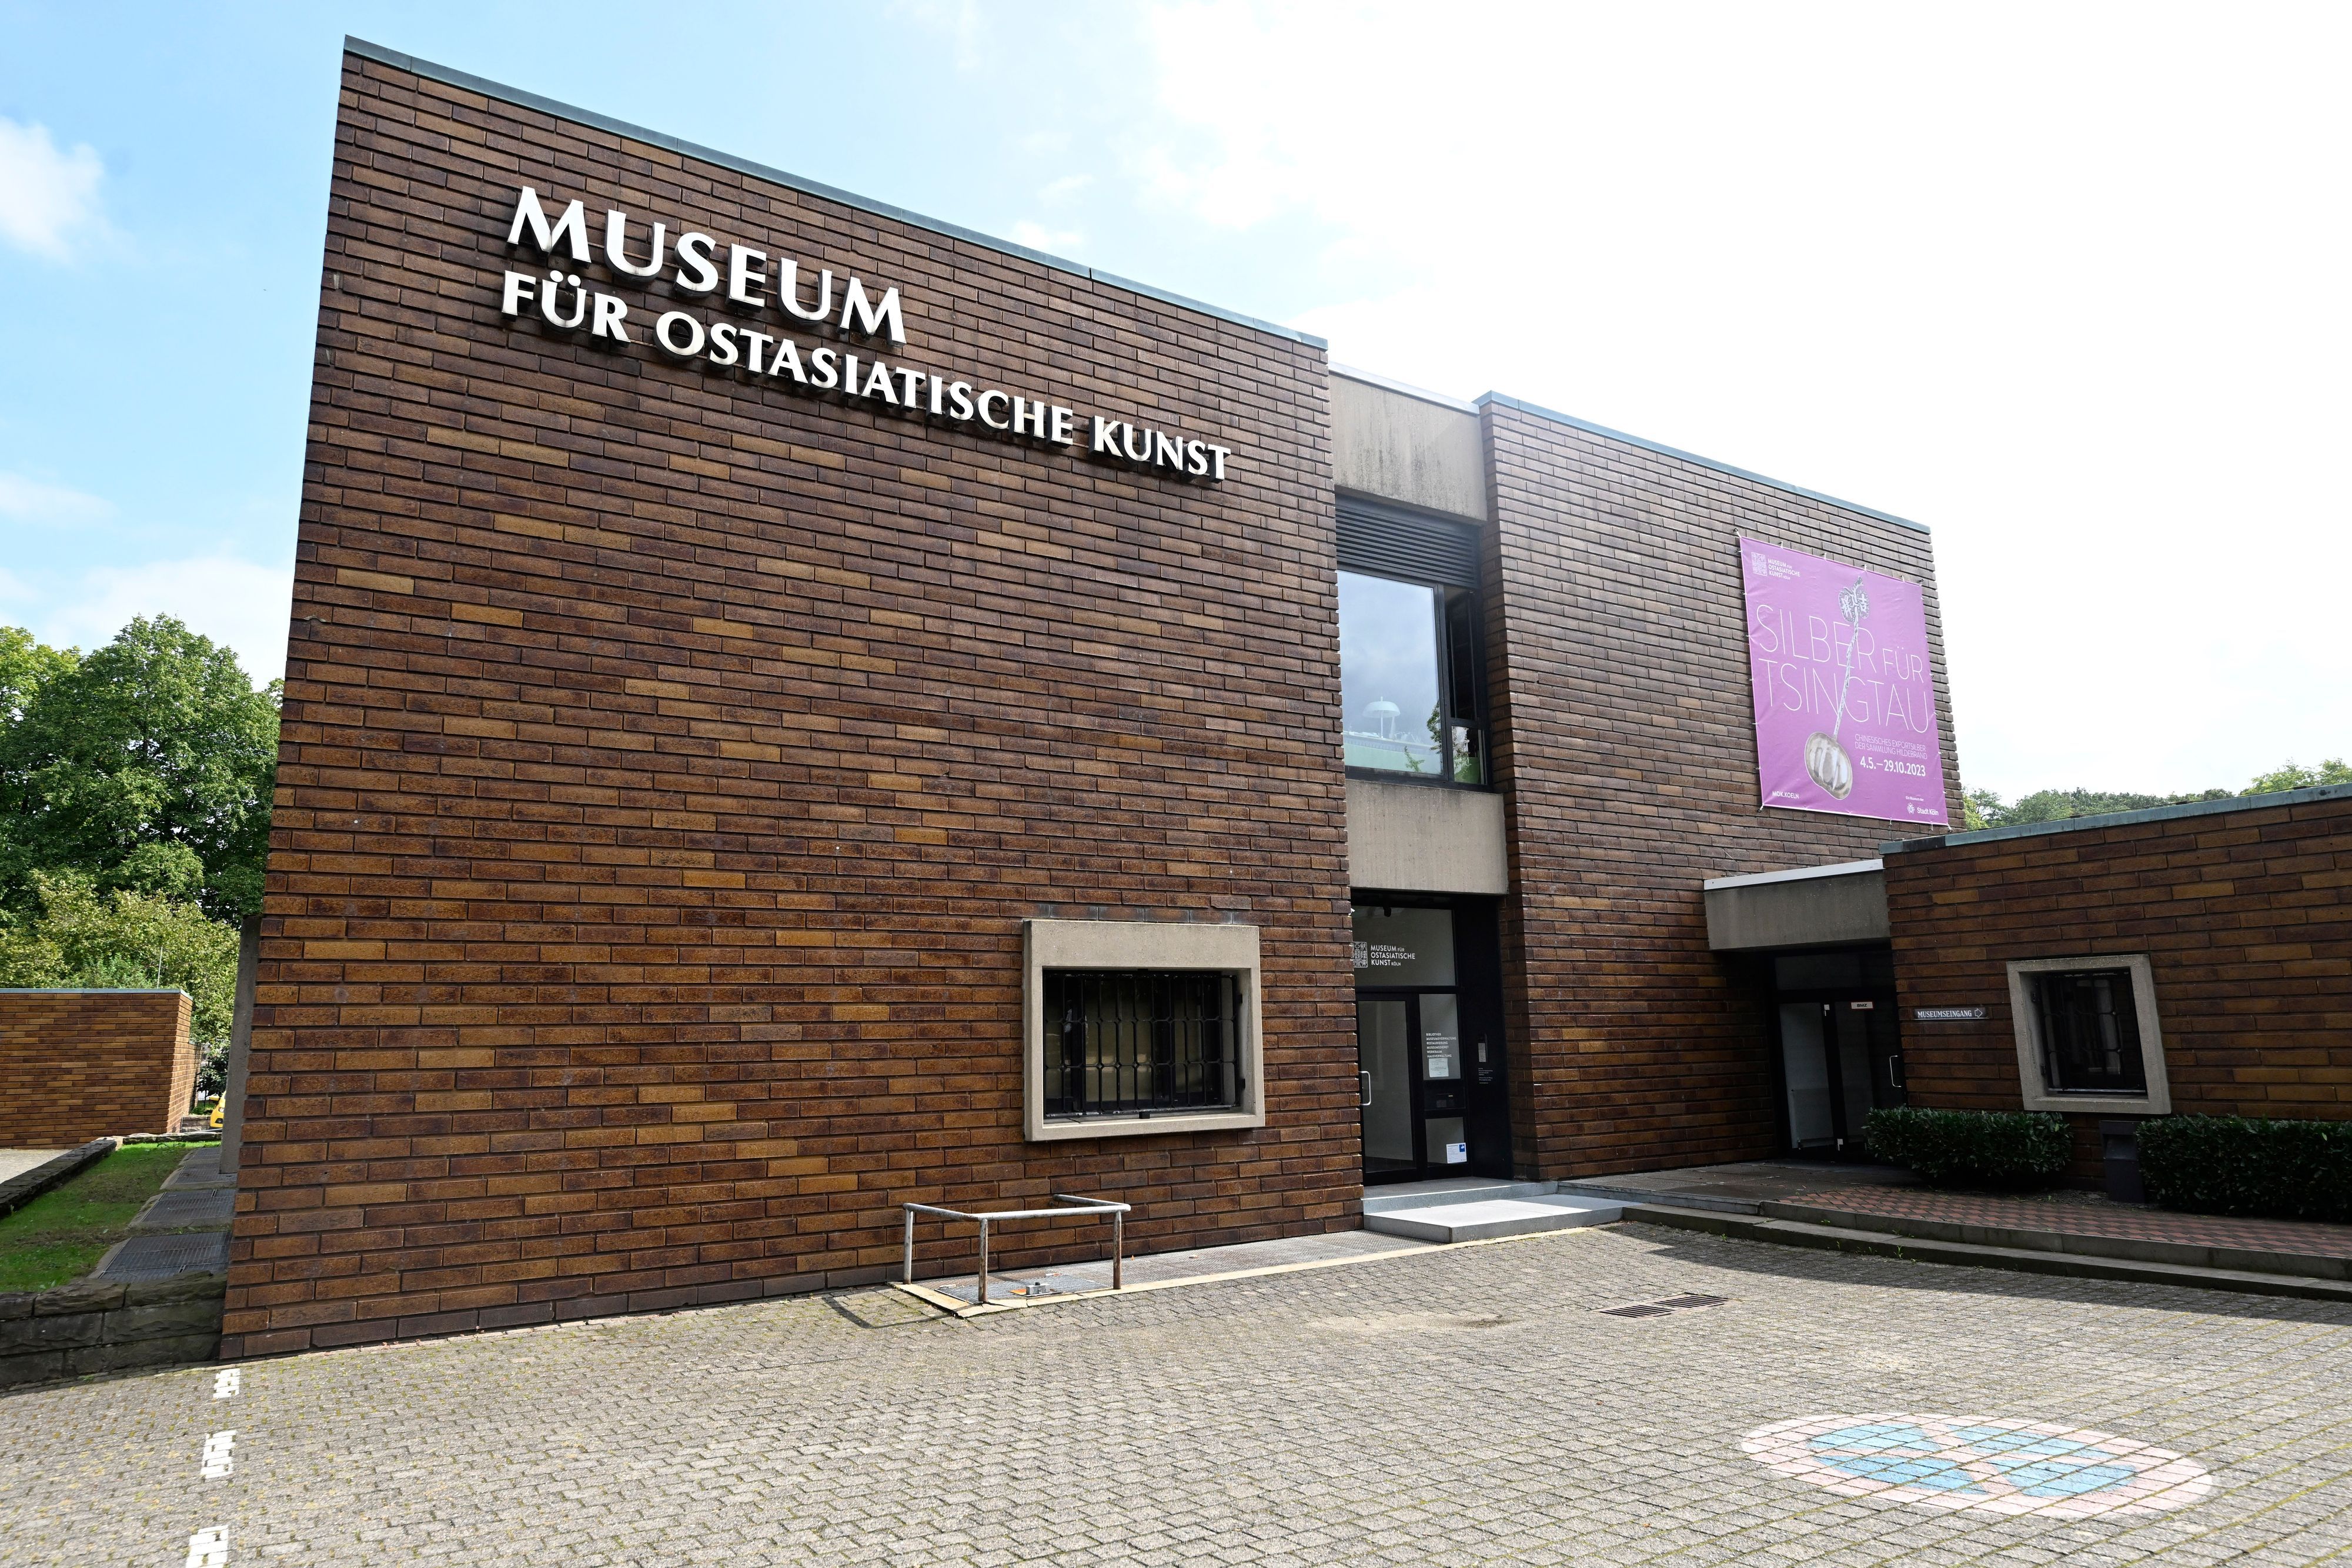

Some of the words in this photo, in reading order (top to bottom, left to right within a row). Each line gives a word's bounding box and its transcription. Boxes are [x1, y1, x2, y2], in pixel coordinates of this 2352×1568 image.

[507, 185, 907, 347] MUSEUM
[501, 269, 632, 347] FÜR
[653, 310, 1074, 449] OSTASIATISCHE
[1088, 415, 1231, 483] KUNST
[1768, 559, 1786, 567] MUSEUM
[1768, 564, 1800, 577] OSTASIATISCHE
[1769, 570, 1783, 579] KUNST
[1756, 604, 1877, 673] SILBER
[1882, 646, 1924, 683] FÜR
[1758, 658, 1929, 733] TSINGTAU
[1855, 734, 1891, 747] CHINESISCHES
[1892, 740, 1926, 752] EXPORTSILBER
[1855, 741, 1865, 750] DER
[1866, 743, 1896, 755] SAMMLUNG
[1896, 749, 1927, 760] HILDEBRAND
[1772, 790, 1799, 800] MOK.KOELN
